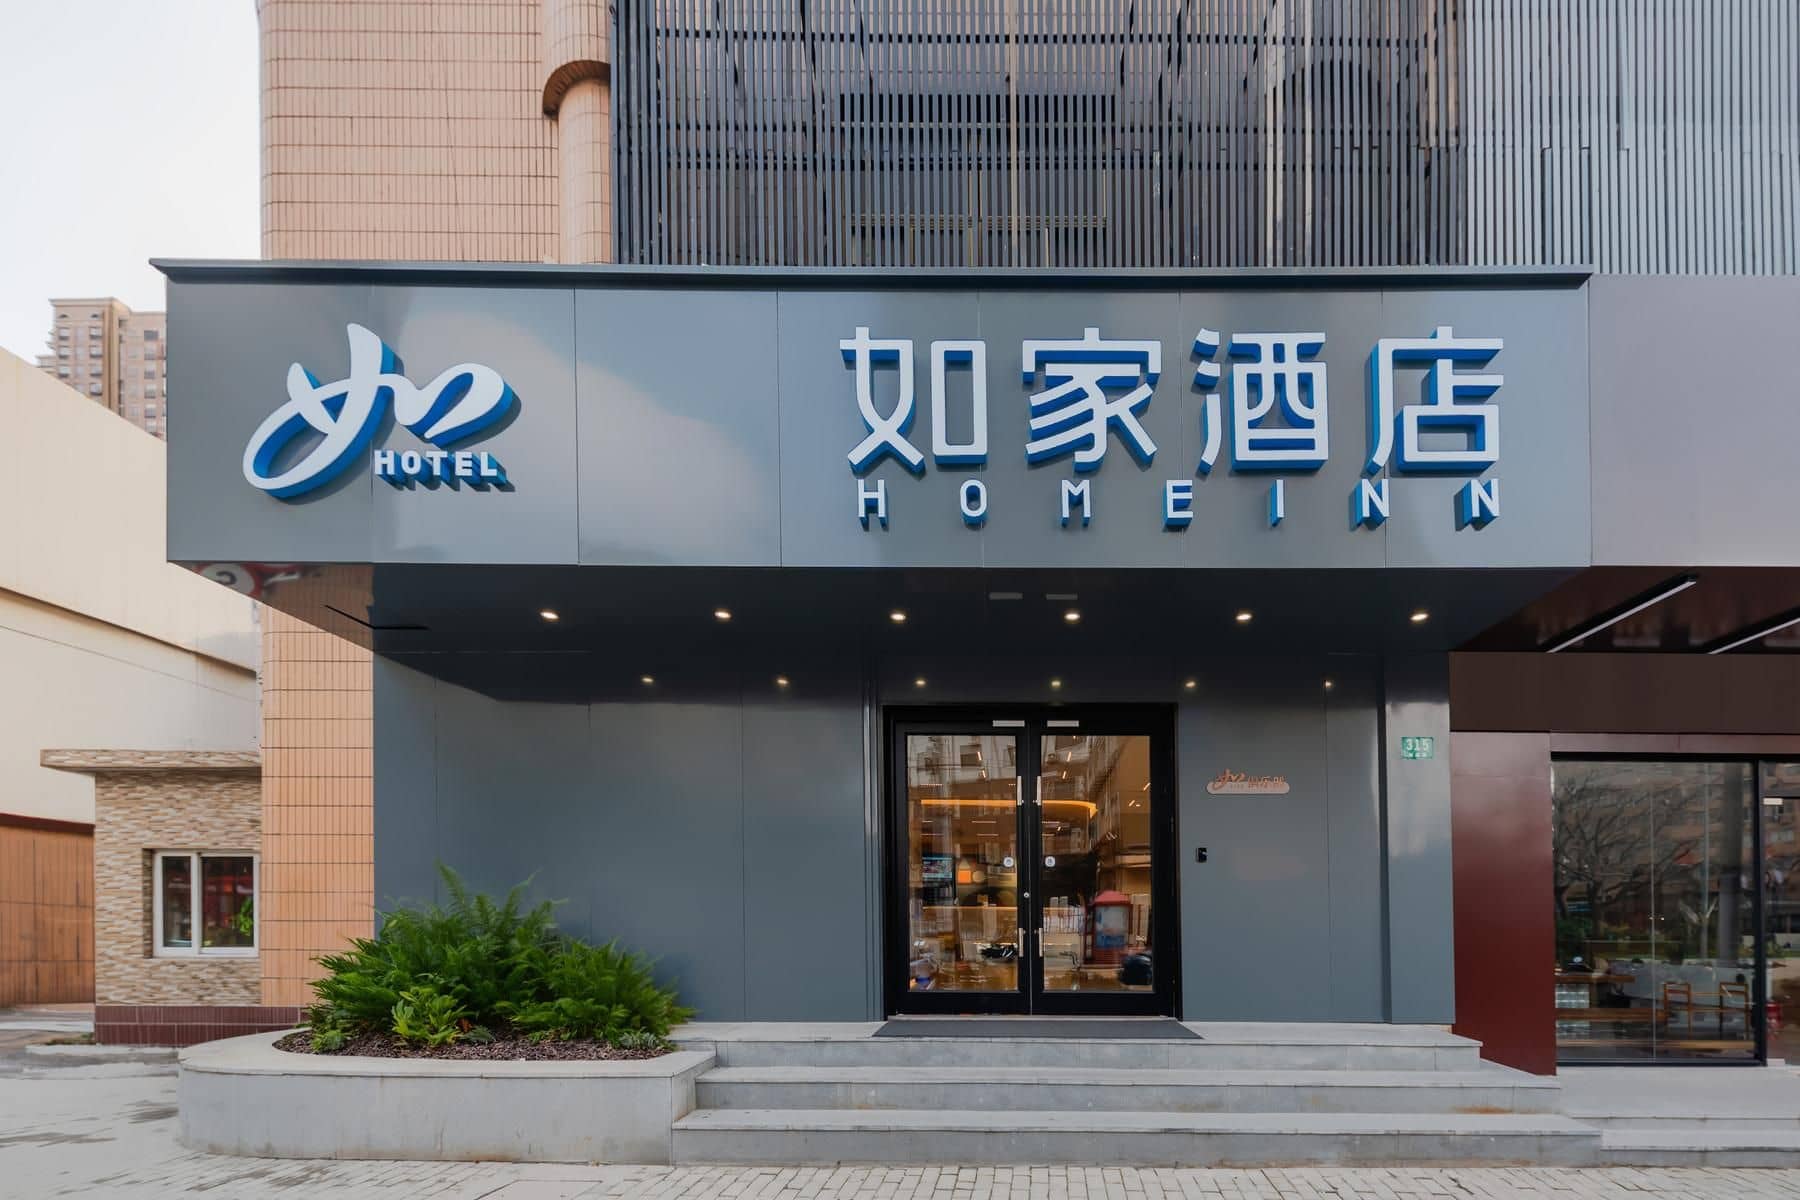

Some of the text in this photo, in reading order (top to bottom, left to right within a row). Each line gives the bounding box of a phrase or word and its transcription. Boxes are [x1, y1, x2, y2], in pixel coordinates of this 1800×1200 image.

[840, 326, 1504, 468] 如家酒店
[374, 450, 499, 478] HOTEL
